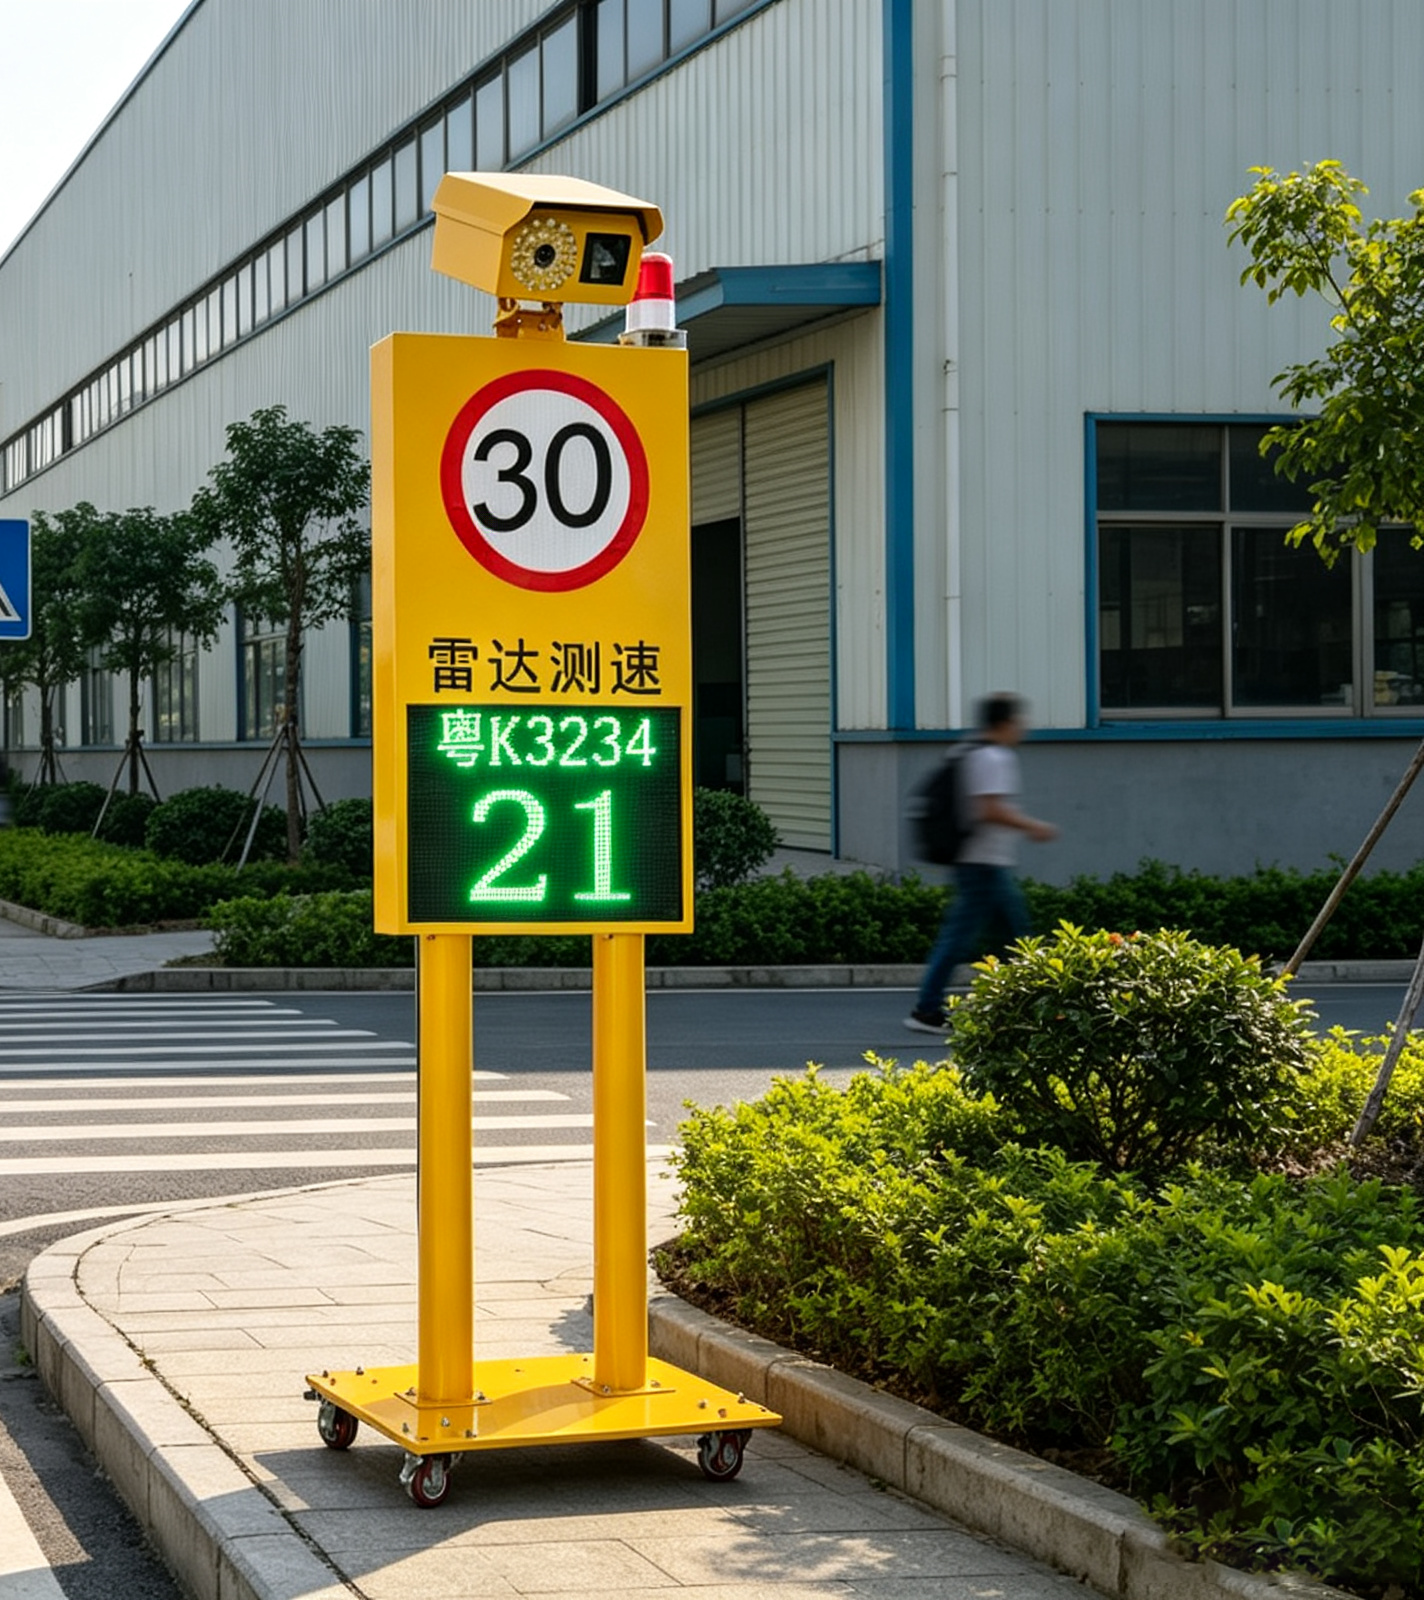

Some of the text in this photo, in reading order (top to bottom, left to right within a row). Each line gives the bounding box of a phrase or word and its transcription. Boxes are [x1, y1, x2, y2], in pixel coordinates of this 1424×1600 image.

[473, 422, 612, 532] 30
[429, 638, 662, 695] 雷达测速
[437, 709, 656, 767] 粤K3234
[470, 789, 631, 901] 21
